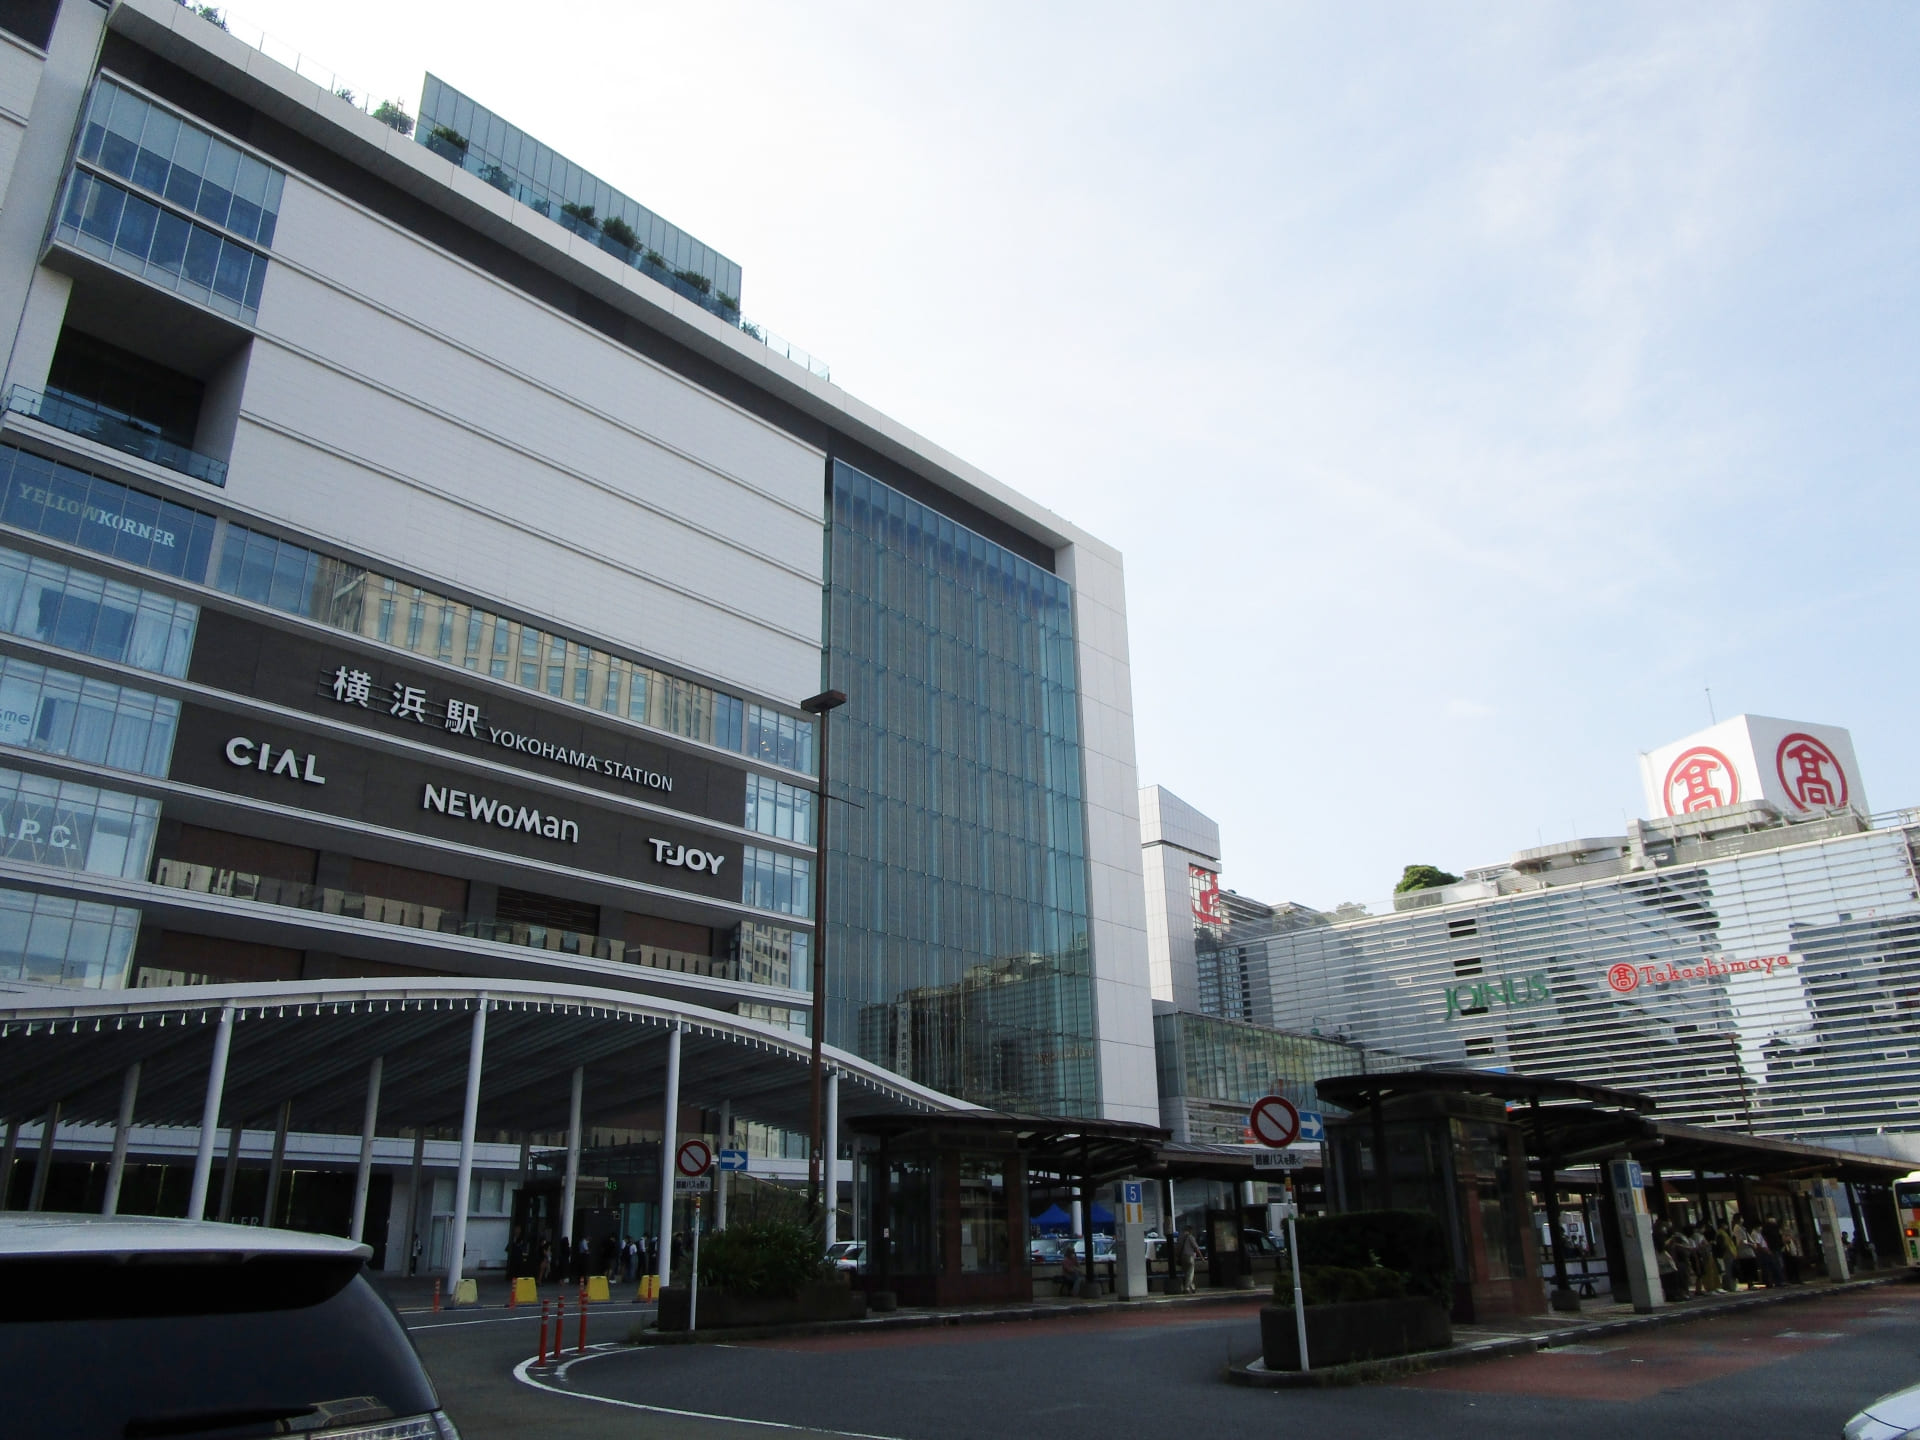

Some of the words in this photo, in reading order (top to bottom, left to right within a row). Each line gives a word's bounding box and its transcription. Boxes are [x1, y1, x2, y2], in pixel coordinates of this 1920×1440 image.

[18, 482, 176, 549] YELLOWKORNER
[333, 665, 480, 739] 横浜駅
[225, 736, 327, 785] CIAL
[488, 725, 598, 772] YOKOHAMA
[603, 759, 673, 792] STATION
[1638, 953, 1791, 985] Takashimaya
[1443, 973, 1550, 1021] JOINUS
[1129, 1186, 1137, 1201] 5
